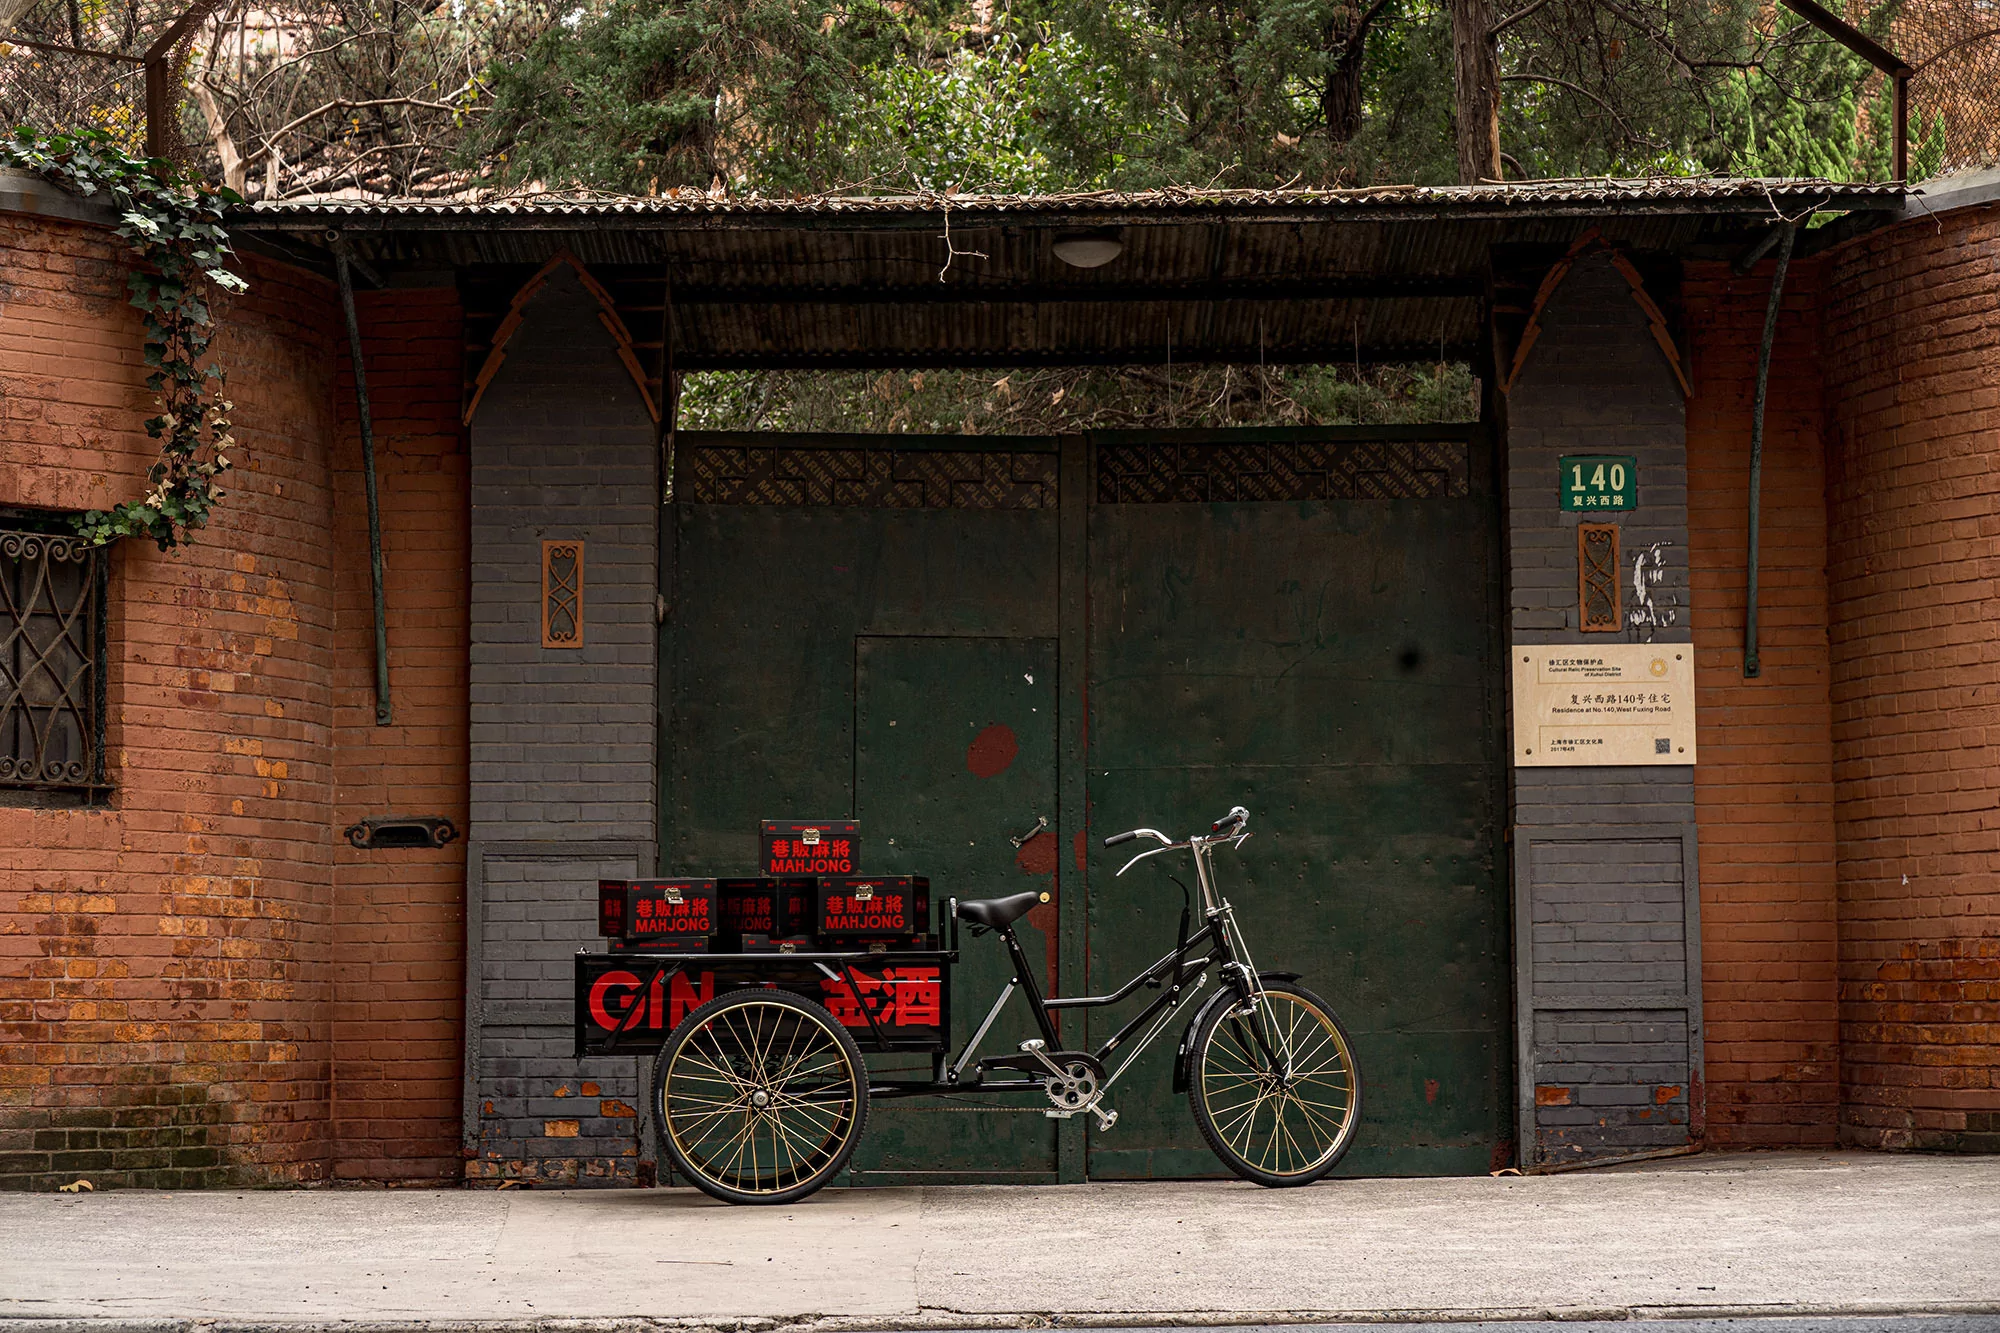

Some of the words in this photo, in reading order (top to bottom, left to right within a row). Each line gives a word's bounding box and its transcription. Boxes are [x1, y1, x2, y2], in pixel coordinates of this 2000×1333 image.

[1571, 464, 1625, 491] 140
[1573, 495, 1624, 506] 复兴西路
[1571, 693, 1671, 705] 复兴西路140号住宅
[1632, 706, 1654, 714] Fuxing
[770, 859, 853, 874] MAHJONG
[635, 917, 711, 933] MAHJONG
[825, 914, 906, 929] MAHJONG
[589, 970, 715, 1032] GIN
[819, 965, 941, 1026] 金酒
